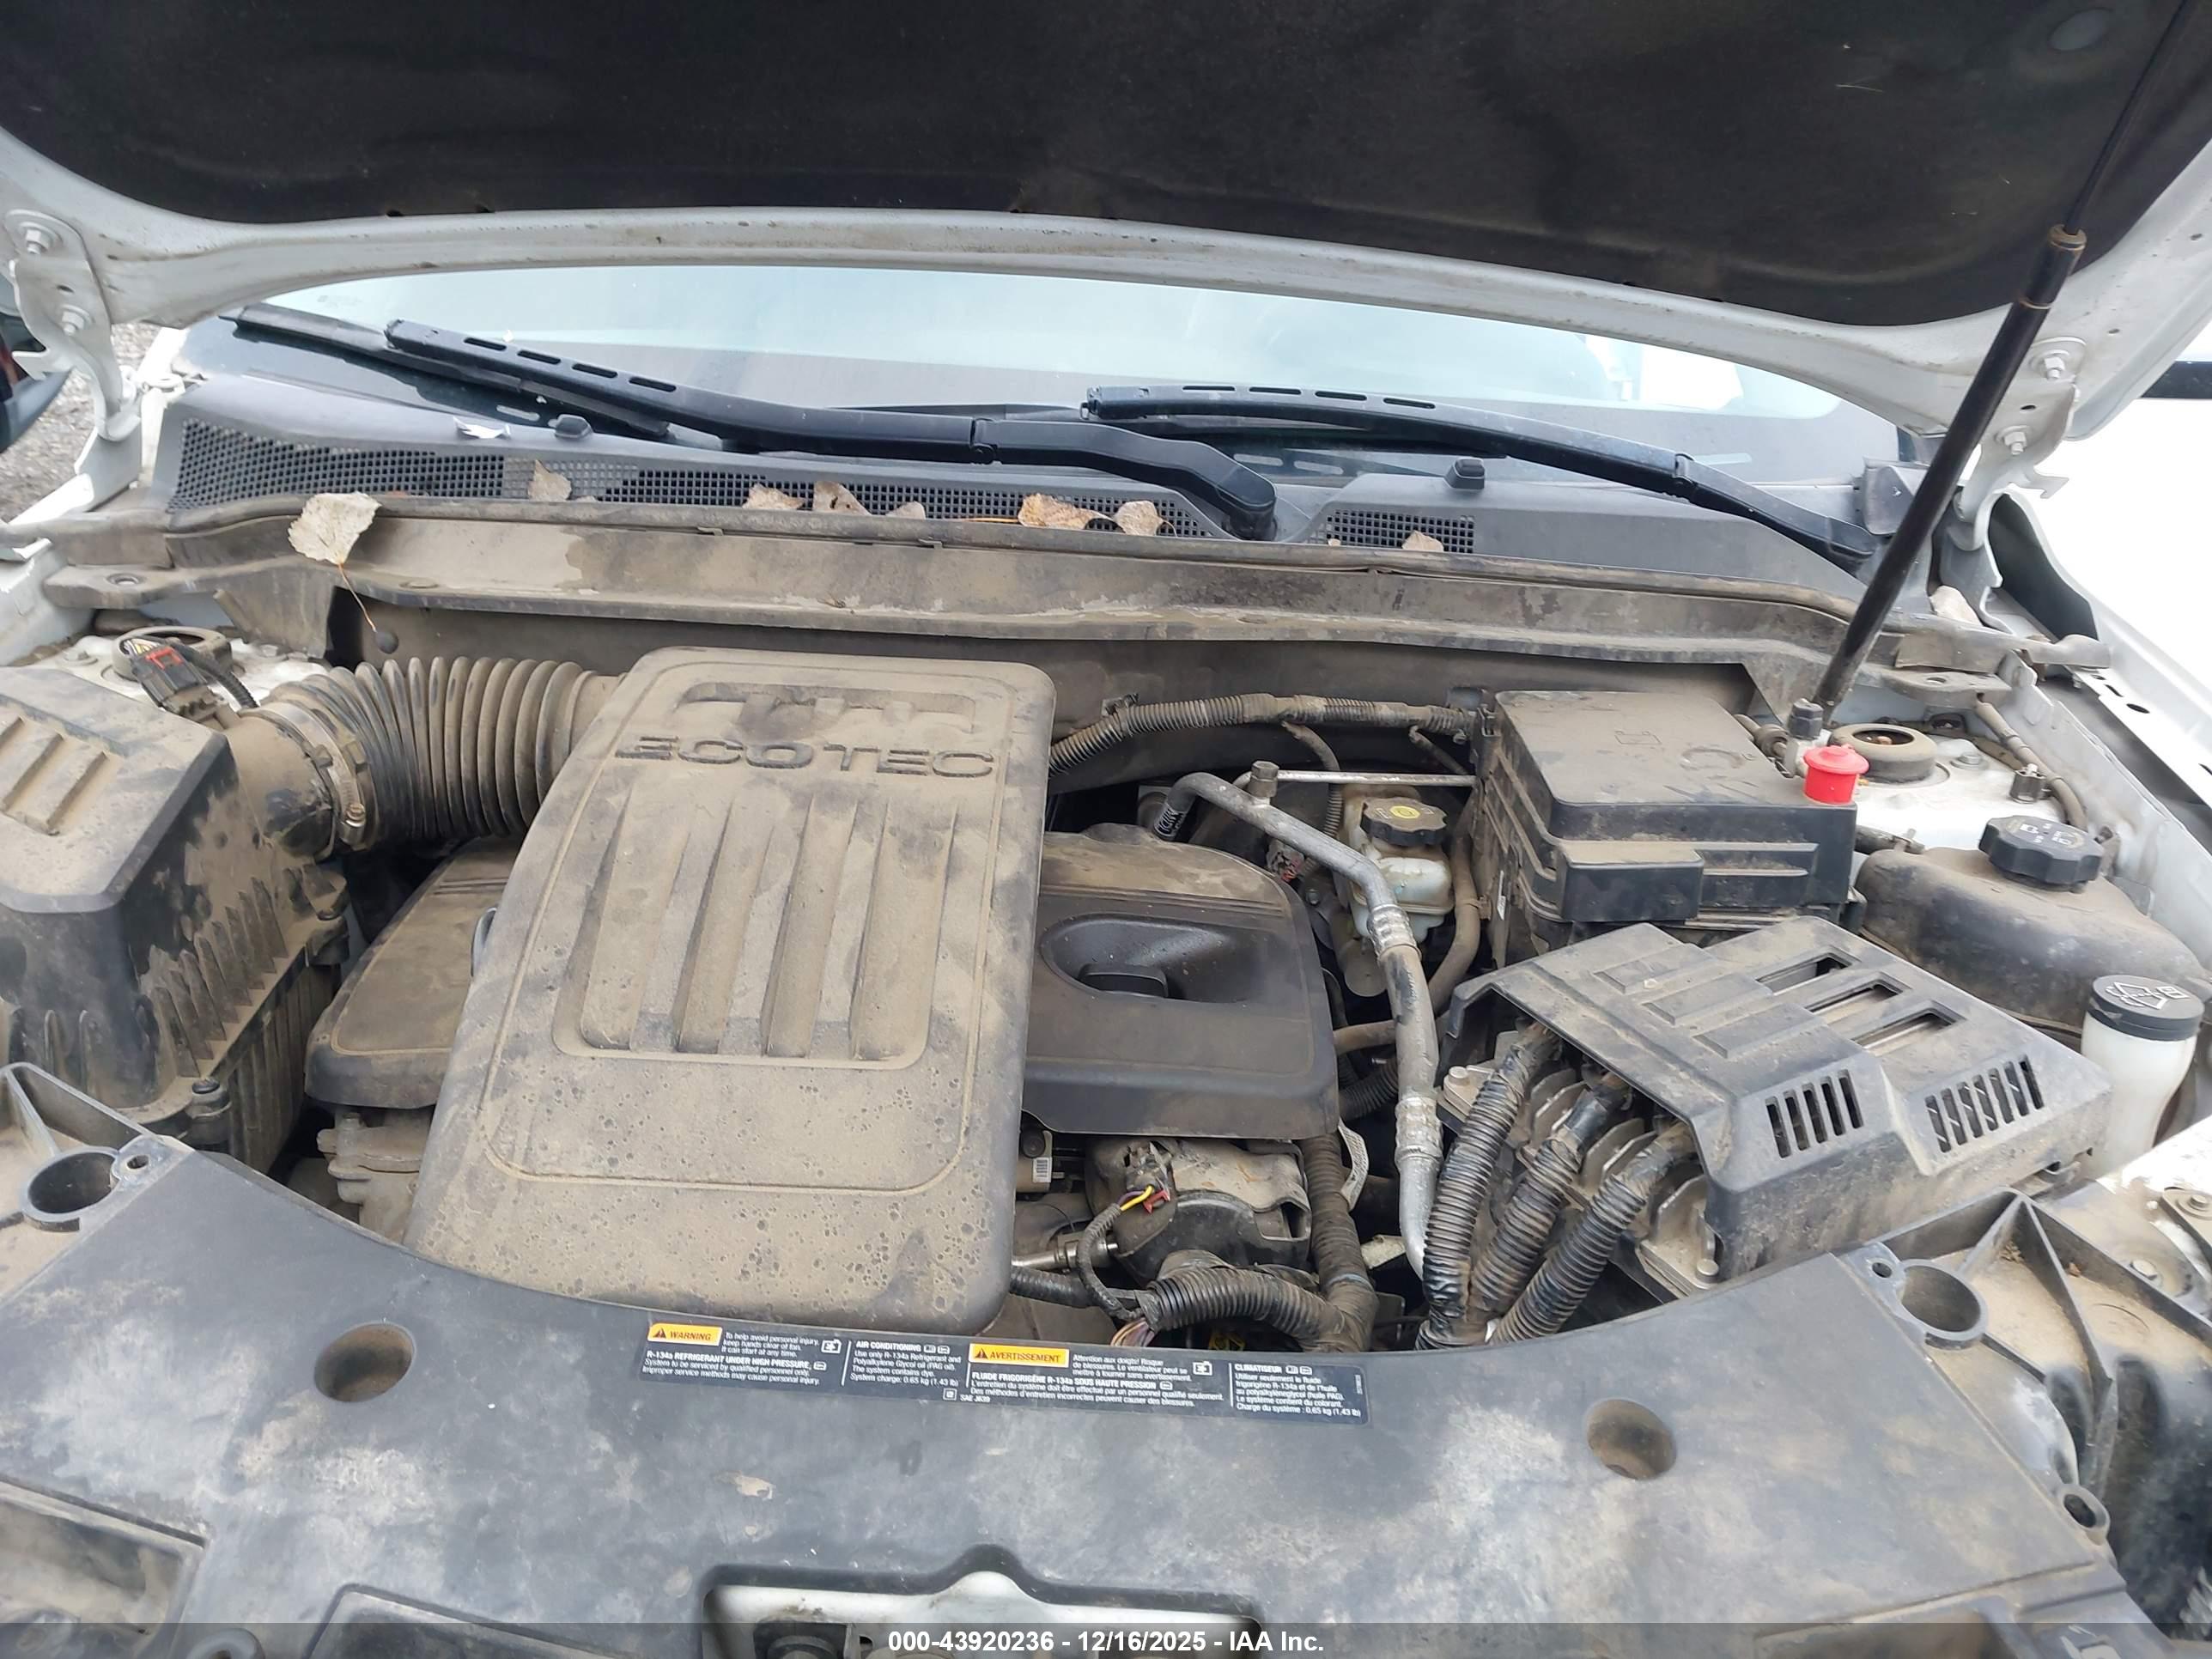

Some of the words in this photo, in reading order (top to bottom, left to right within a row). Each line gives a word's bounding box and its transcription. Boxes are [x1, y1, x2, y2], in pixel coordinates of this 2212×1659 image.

[615, 736, 994, 778] ECOTEC
[670, 1330, 711, 1340] WARNING
[734, 1333, 749, 1341] help
[750, 1334, 769, 1342] avoid
[769, 1335, 799, 1344] personal
[799, 1337, 819, 1346] injury.
[855, 1340, 869, 1349] AIR
[870, 1341, 921, 1352] CONDITIONING
[647, 1350, 673, 1359] R-134a
[674, 1352, 724, 1363] REFRIGERANT
[726, 1356, 750, 1364] UNDER
[751, 1358, 770, 1366] HIGH
[767, 1349, 780, 1358] any
[854, 1349, 867, 1358] Use
[868, 1351, 883, 1359] only
[884, 1352, 909, 1360] R-134a
[910, 1353, 947, 1363] Refrigerant
[948, 1355, 961, 1364] and
[989, 1351, 1061, 1363] AVERTISSEMENT
[1073, 1353, 1103, 1363] Attention
[1140, 1358, 1164, 1366] Risque
[645, 1358, 670, 1368] System
[730, 1364, 759, 1373] qualified
[760, 1366, 793, 1375] personnel
[853, 1358, 895, 1367] Polyalkylene
[895, 1359, 916, 1369] Glycol
[1234, 1364, 1282, 1374] CLIMATISEUR
[642, 1366, 673, 1376] Improper
[700, 1370, 730, 1378] methods
[732, 1372, 746, 1381] may
[769, 1375, 799, 1383] personal
[866, 1366, 890, 1375] system
[891, 1367, 920, 1376] contains
[1235, 1372, 1258, 1381] Utiliser
[1259, 1375, 1294, 1383] seulement
[850, 1372, 875, 1382] System
[920, 1376, 930, 1386] kg
[971, 1371, 997, 1381] FLUIDE
[1047, 1376, 1073, 1385] R-134a
[1074, 1377, 1094, 1386] SOUS
[1095, 1379, 1119, 1388] HAUTE
[1120, 1380, 1157, 1389] PRESSION
[970, 1380, 1006, 1389] L'entretien
[1018, 1382, 1046, 1391] système
[1047, 1383, 1060, 1392] doit
[1076, 1386, 1103, 1395] effectué
[1161, 1391, 1187, 1400] qualifié
[960, 1394, 974, 1402] SAE
[984, 1389, 1018, 1397] méthodes
[1019, 1389, 1055, 1399] d'entretien
[1056, 1392, 1094, 1401] incorrectes
[1095, 1395, 1123, 1403] peuvent
[1123, 1396, 1146, 1405] causer
[1246, 1396, 1274, 1405] système
[1275, 1397, 1303, 1406] contient
[1237, 1402, 1261, 1412] Charge
[1272, 1405, 1301, 1413] système
[1322, 1408, 1332, 1417] kg
